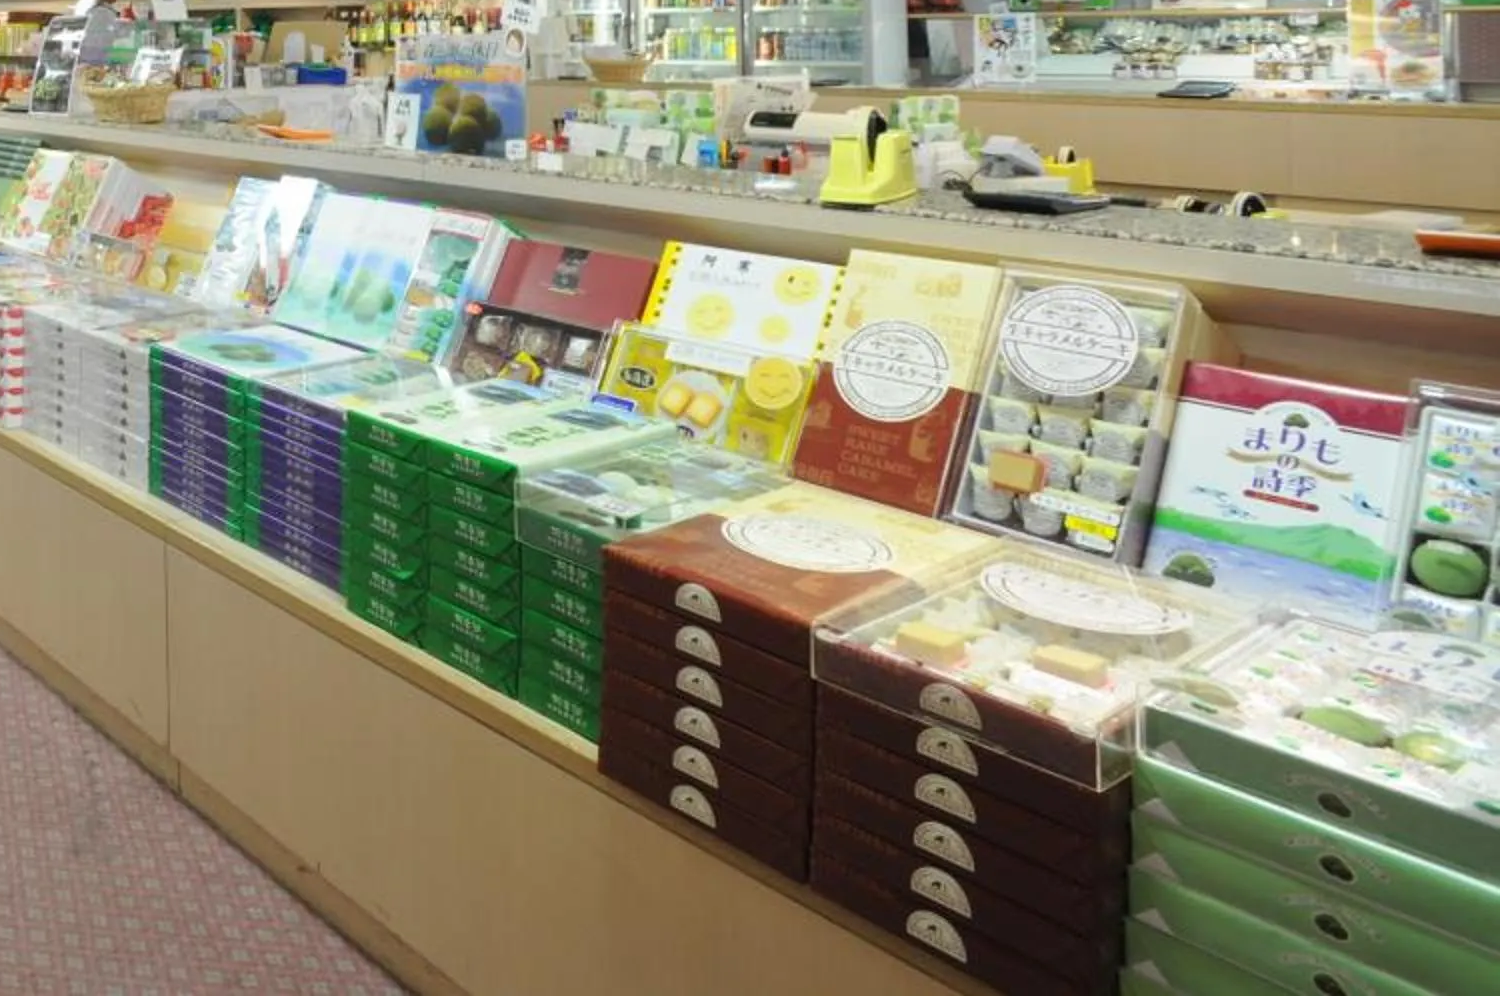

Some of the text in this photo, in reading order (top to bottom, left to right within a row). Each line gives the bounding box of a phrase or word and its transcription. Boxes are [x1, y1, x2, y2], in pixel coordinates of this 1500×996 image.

[1243, 427, 1341, 465] まりも
[1277, 453, 1301, 469] の
[1251, 467, 1317, 498] 時季
